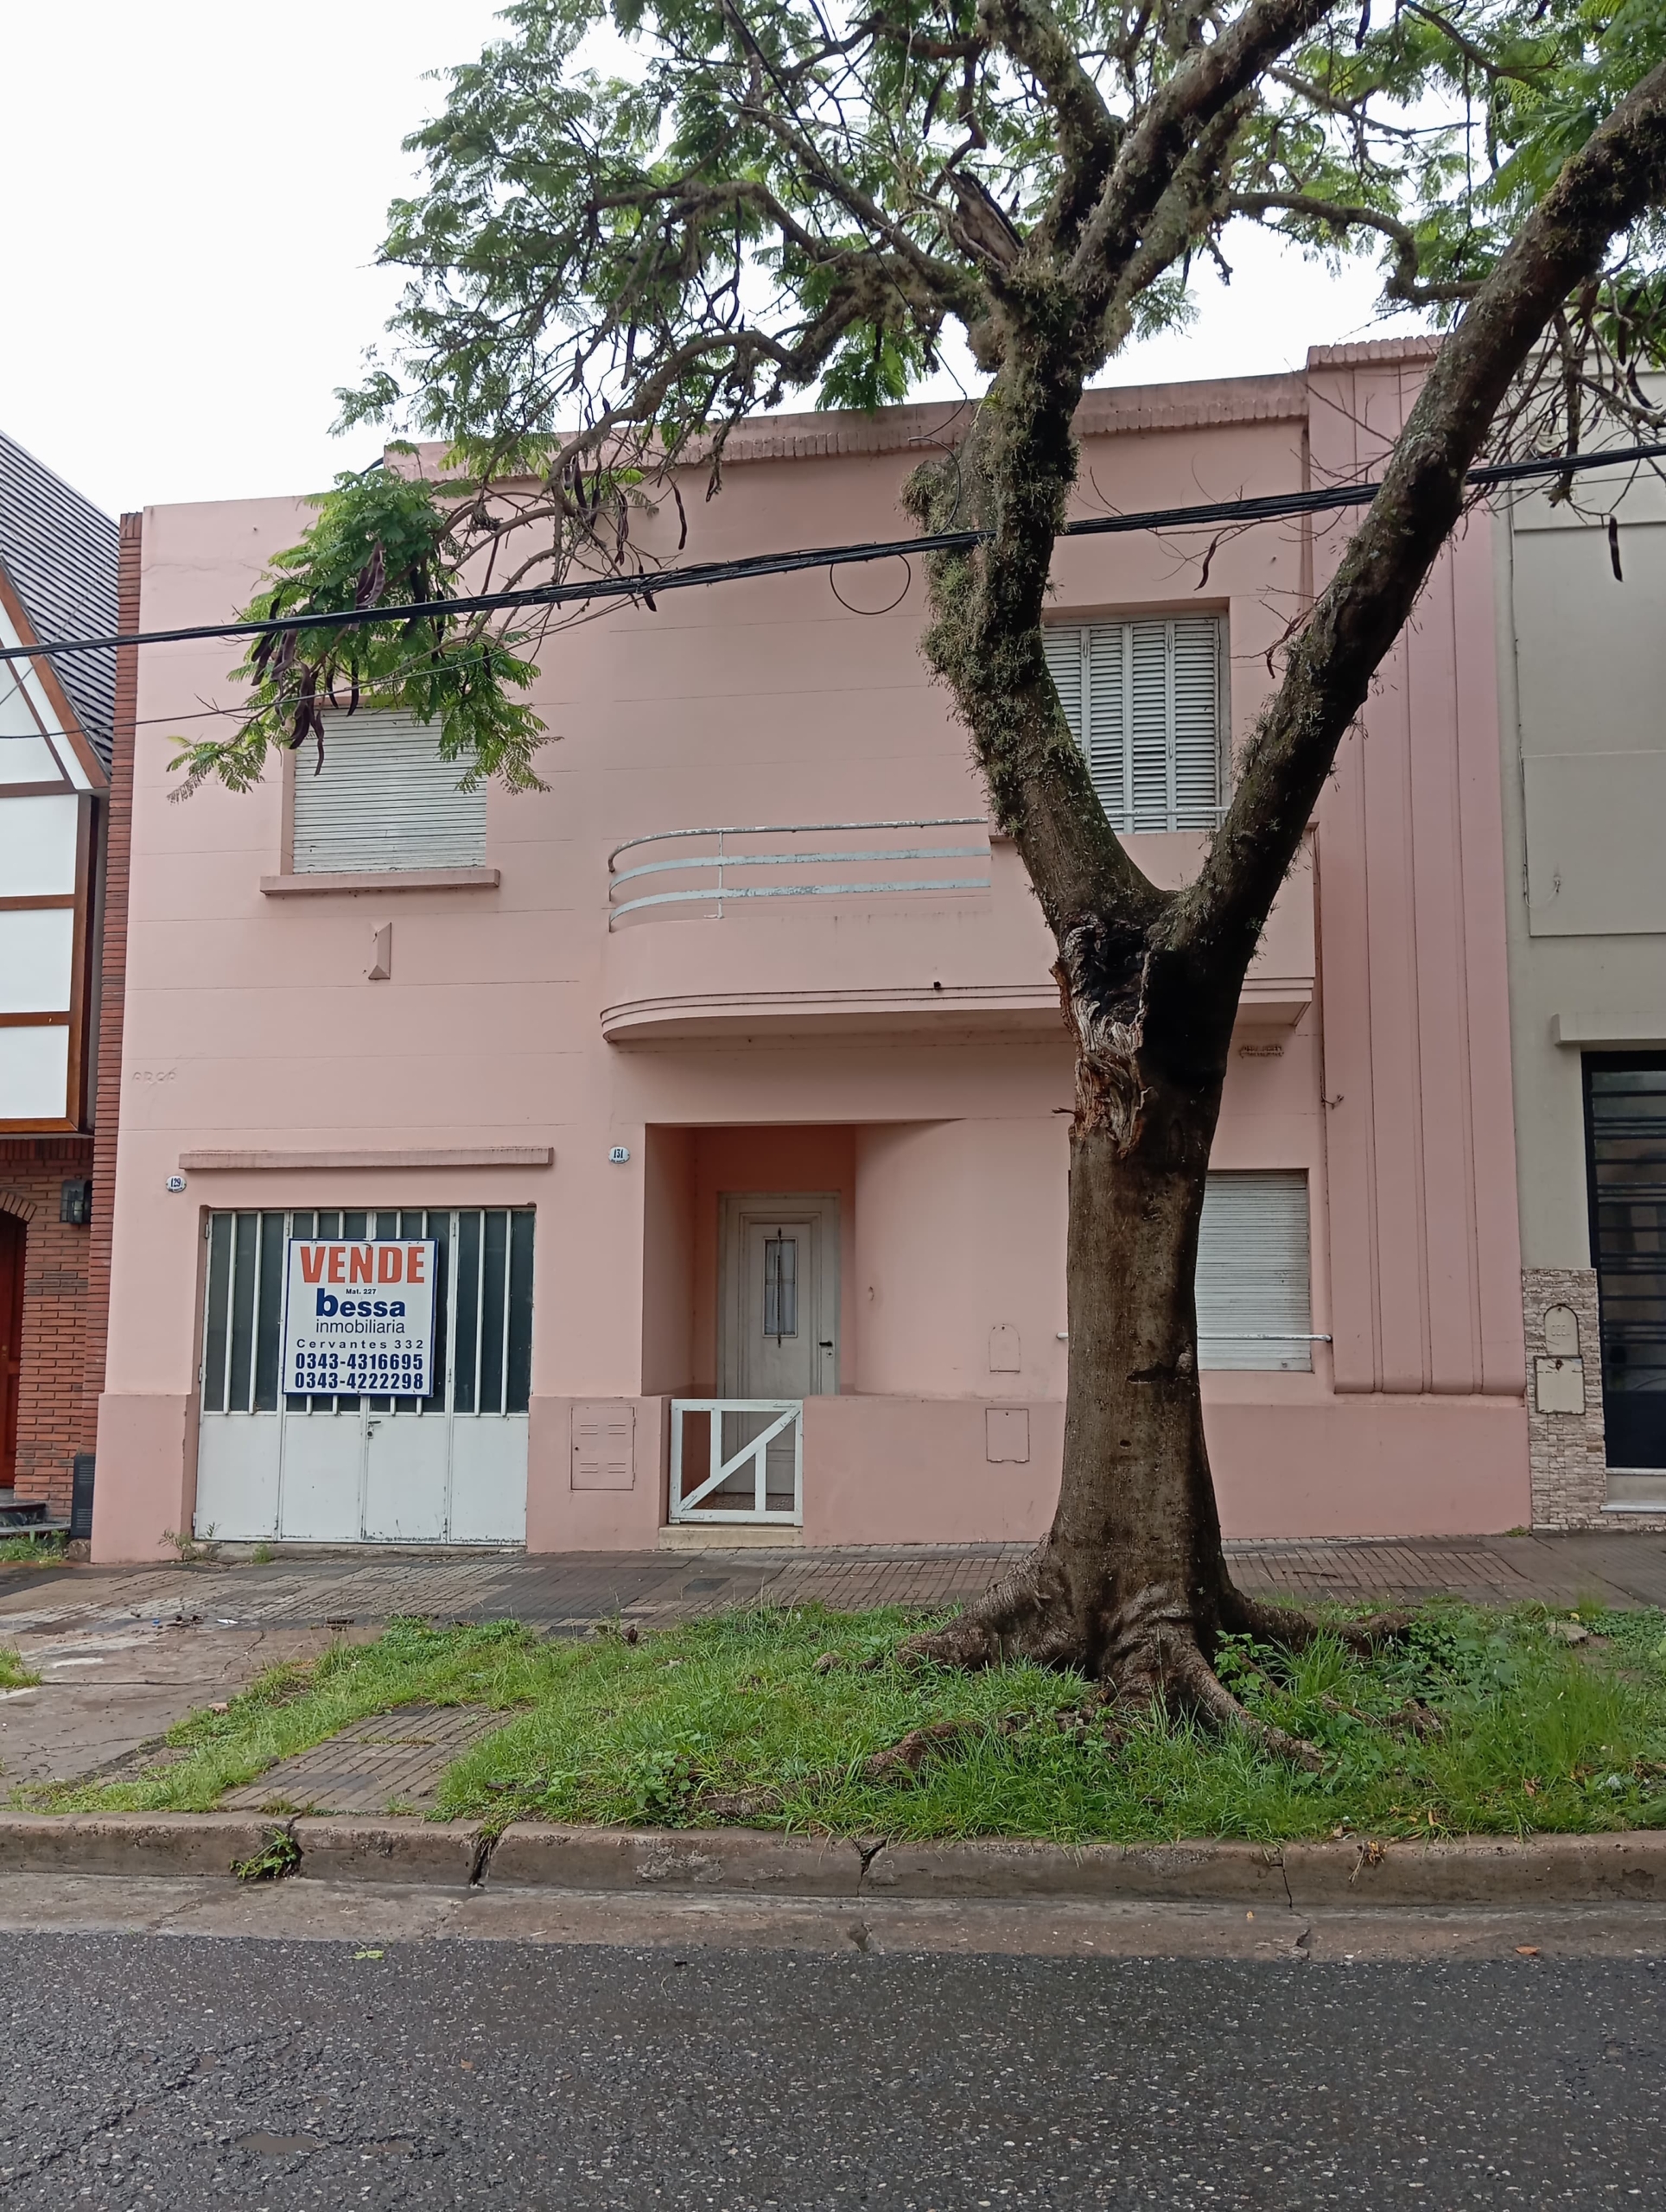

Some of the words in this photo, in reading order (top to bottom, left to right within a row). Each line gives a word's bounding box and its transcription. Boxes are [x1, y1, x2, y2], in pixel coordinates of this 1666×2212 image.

[614, 1148, 624, 1159] 131
[170, 1177, 181, 1187] 129
[300, 1246, 425, 1284] VENDE
[315, 1287, 405, 1318] bessa
[316, 1319, 405, 1334] inmobiliaria
[296, 1338, 387, 1350] Cervantes
[394, 1339, 423, 1350] 332
[296, 1352, 423, 1370] 0343-4316695
[295, 1372, 423, 1390] 0343-4222298
